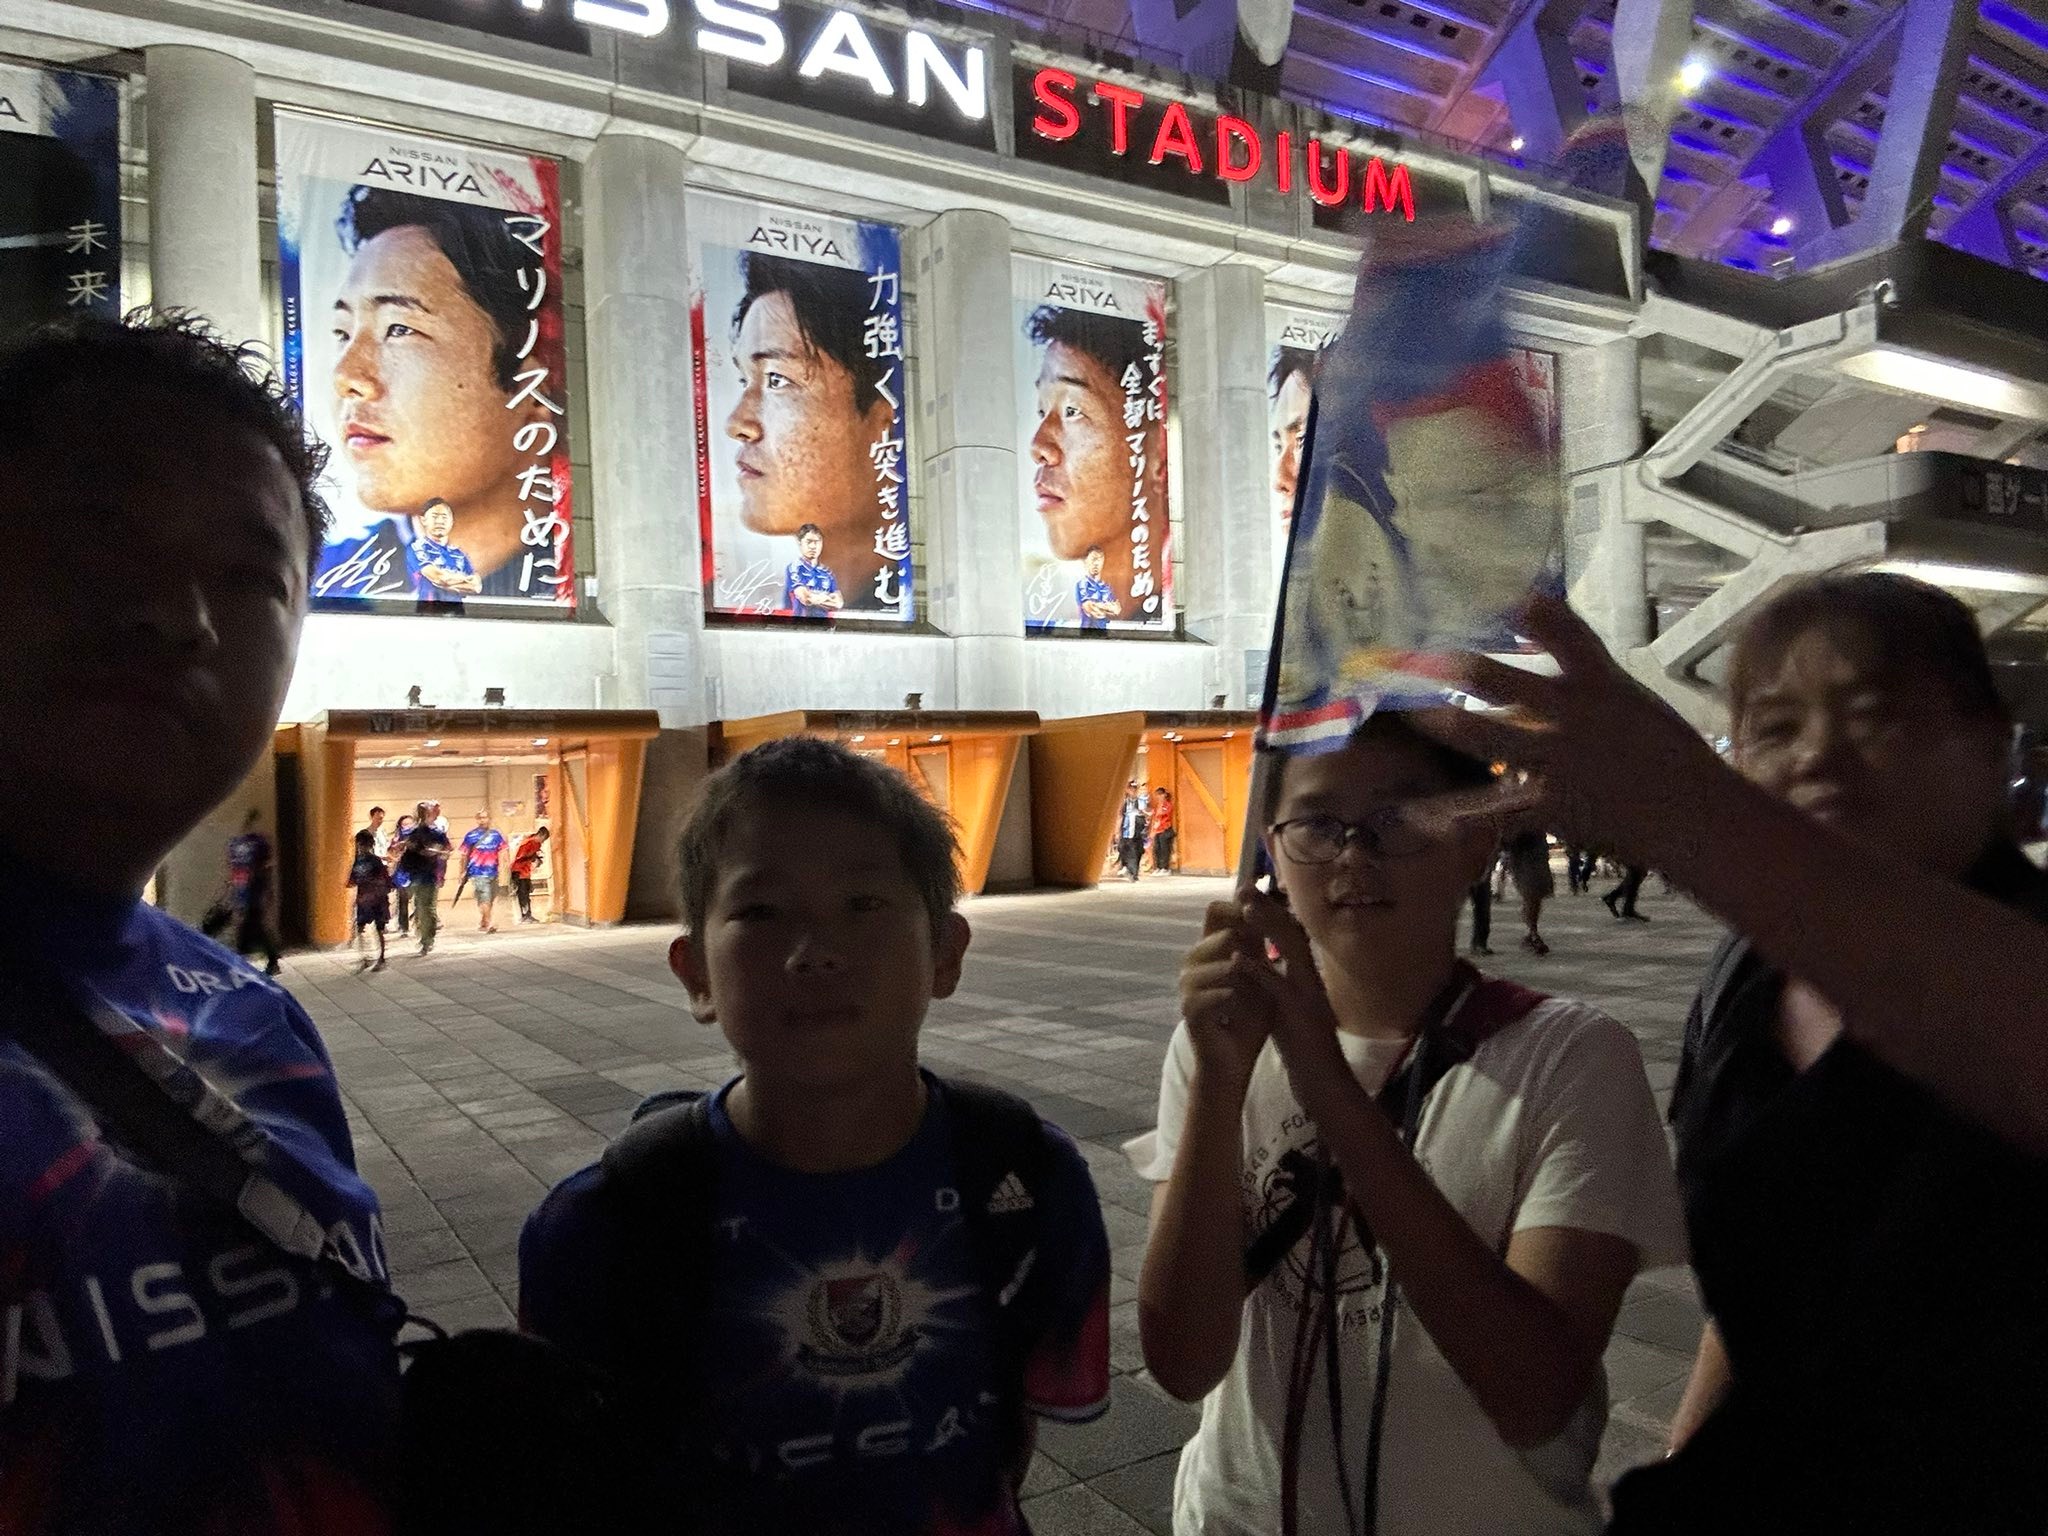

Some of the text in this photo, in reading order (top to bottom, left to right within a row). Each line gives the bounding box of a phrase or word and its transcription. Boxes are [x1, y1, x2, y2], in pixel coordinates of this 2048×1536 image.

[388, 145, 459, 167] NISSAN
[1031, 67, 1417, 223] STADIUM
[361, 157, 488, 198] ARIYA
[769, 216, 823, 234] NISSAN
[746, 226, 846, 262] ARIYA
[1044, 282, 1121, 311] ARIYA
[503, 213, 571, 592] マリノスのために
